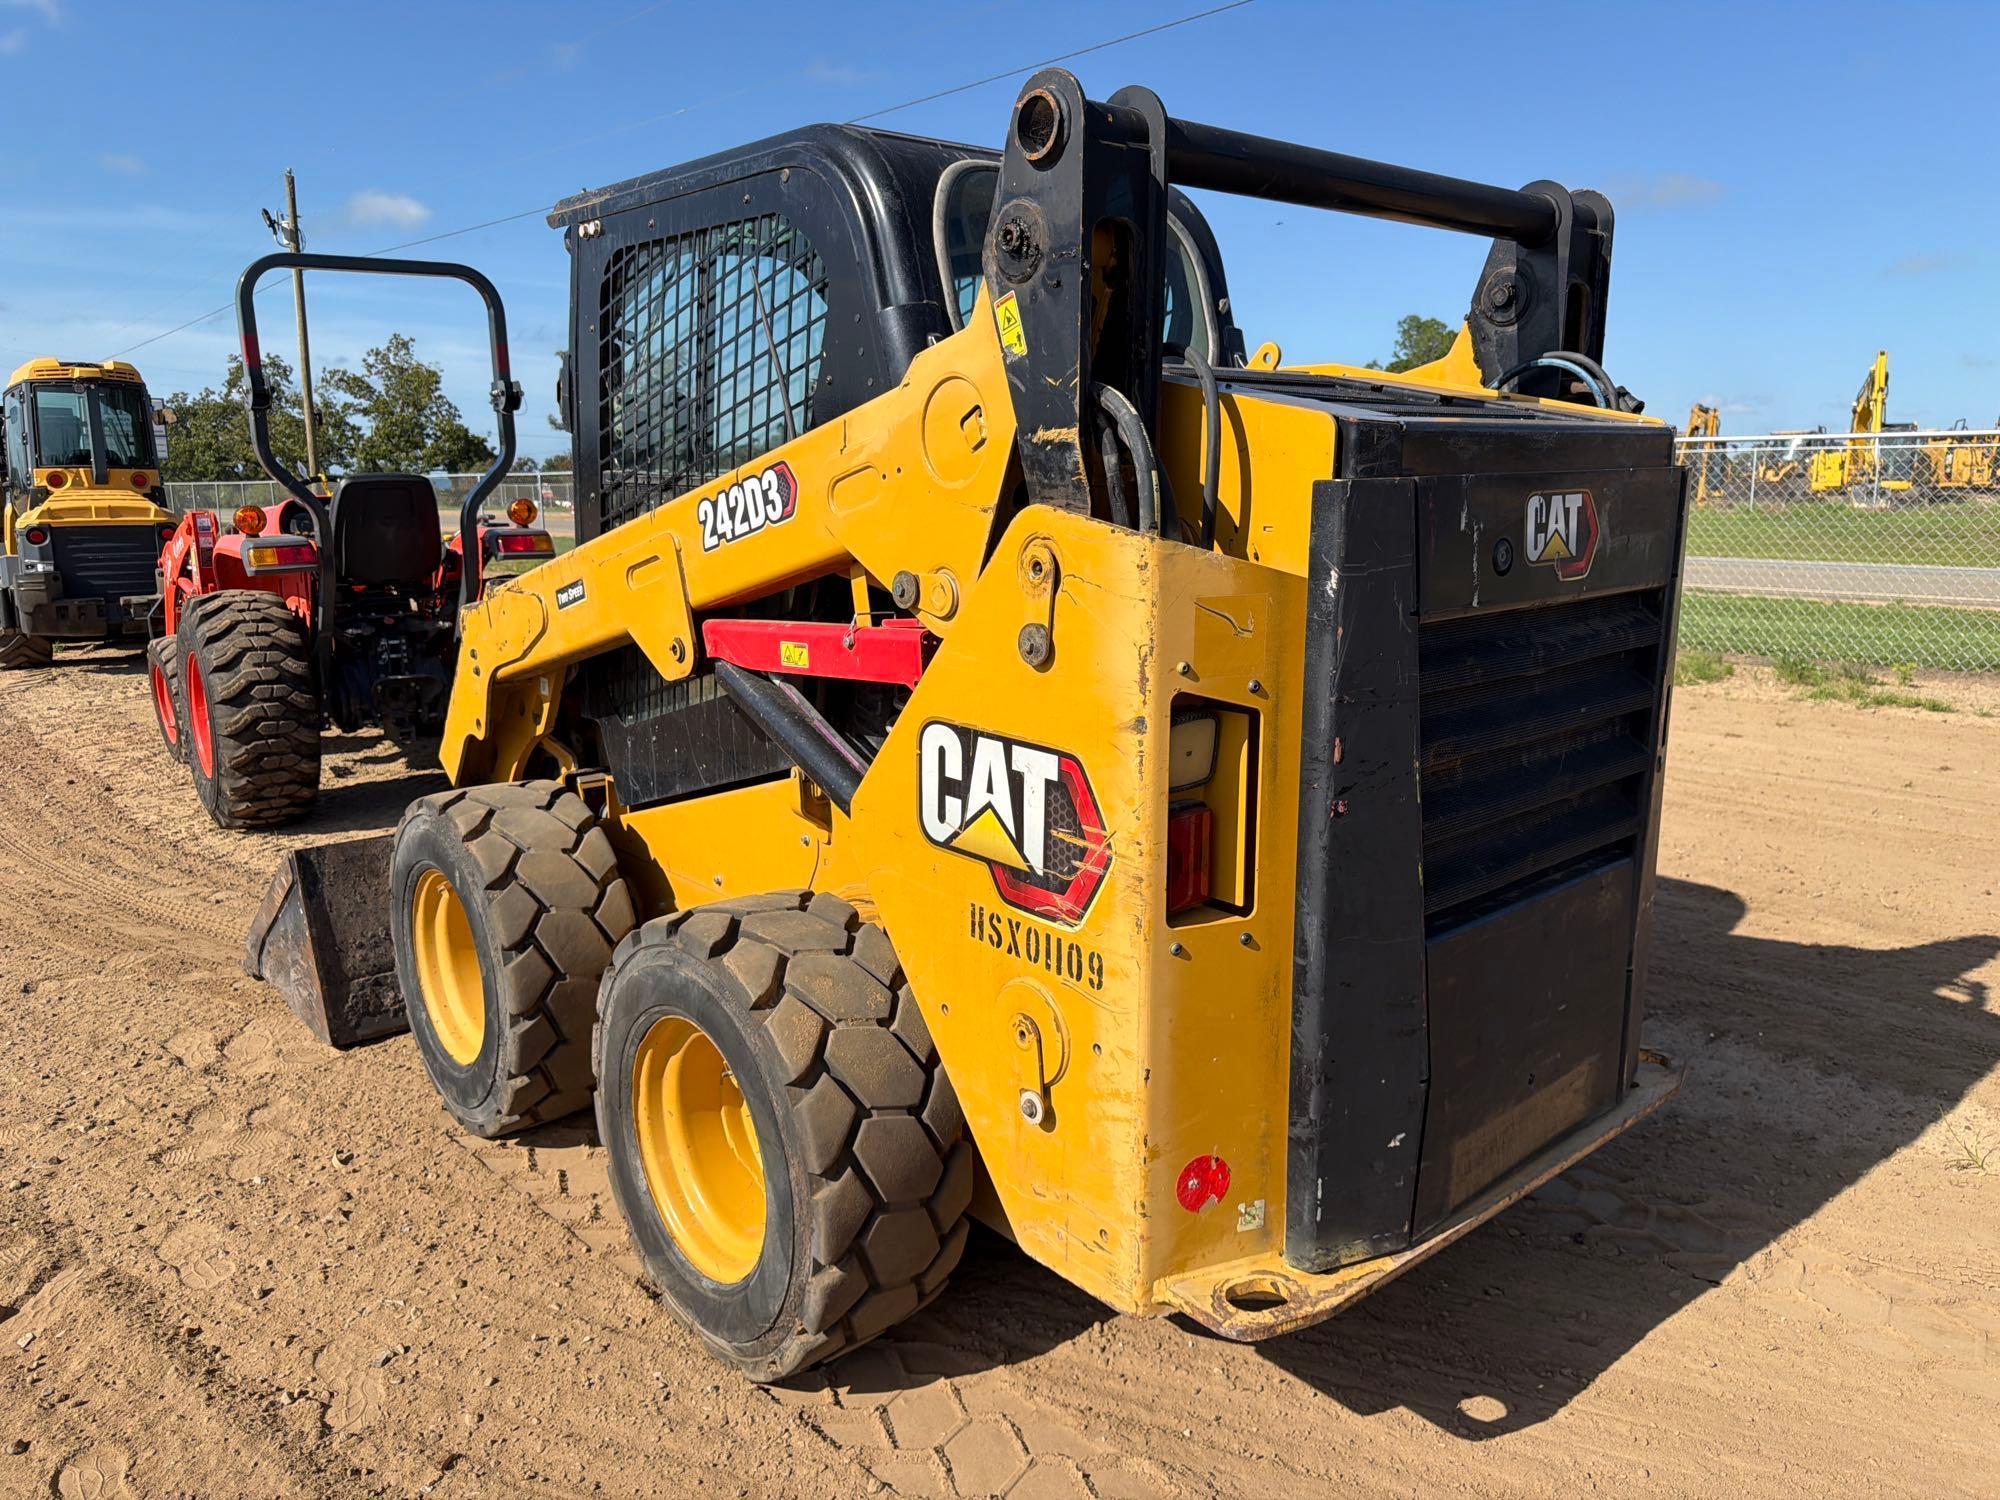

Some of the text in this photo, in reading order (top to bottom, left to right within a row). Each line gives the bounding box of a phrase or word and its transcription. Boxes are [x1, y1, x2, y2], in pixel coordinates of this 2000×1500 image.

[698, 469, 783, 550] 242D3
[1526, 493, 1583, 562] CAT
[921, 723, 1059, 877] CAT
[970, 902, 1104, 991] HSX01109
